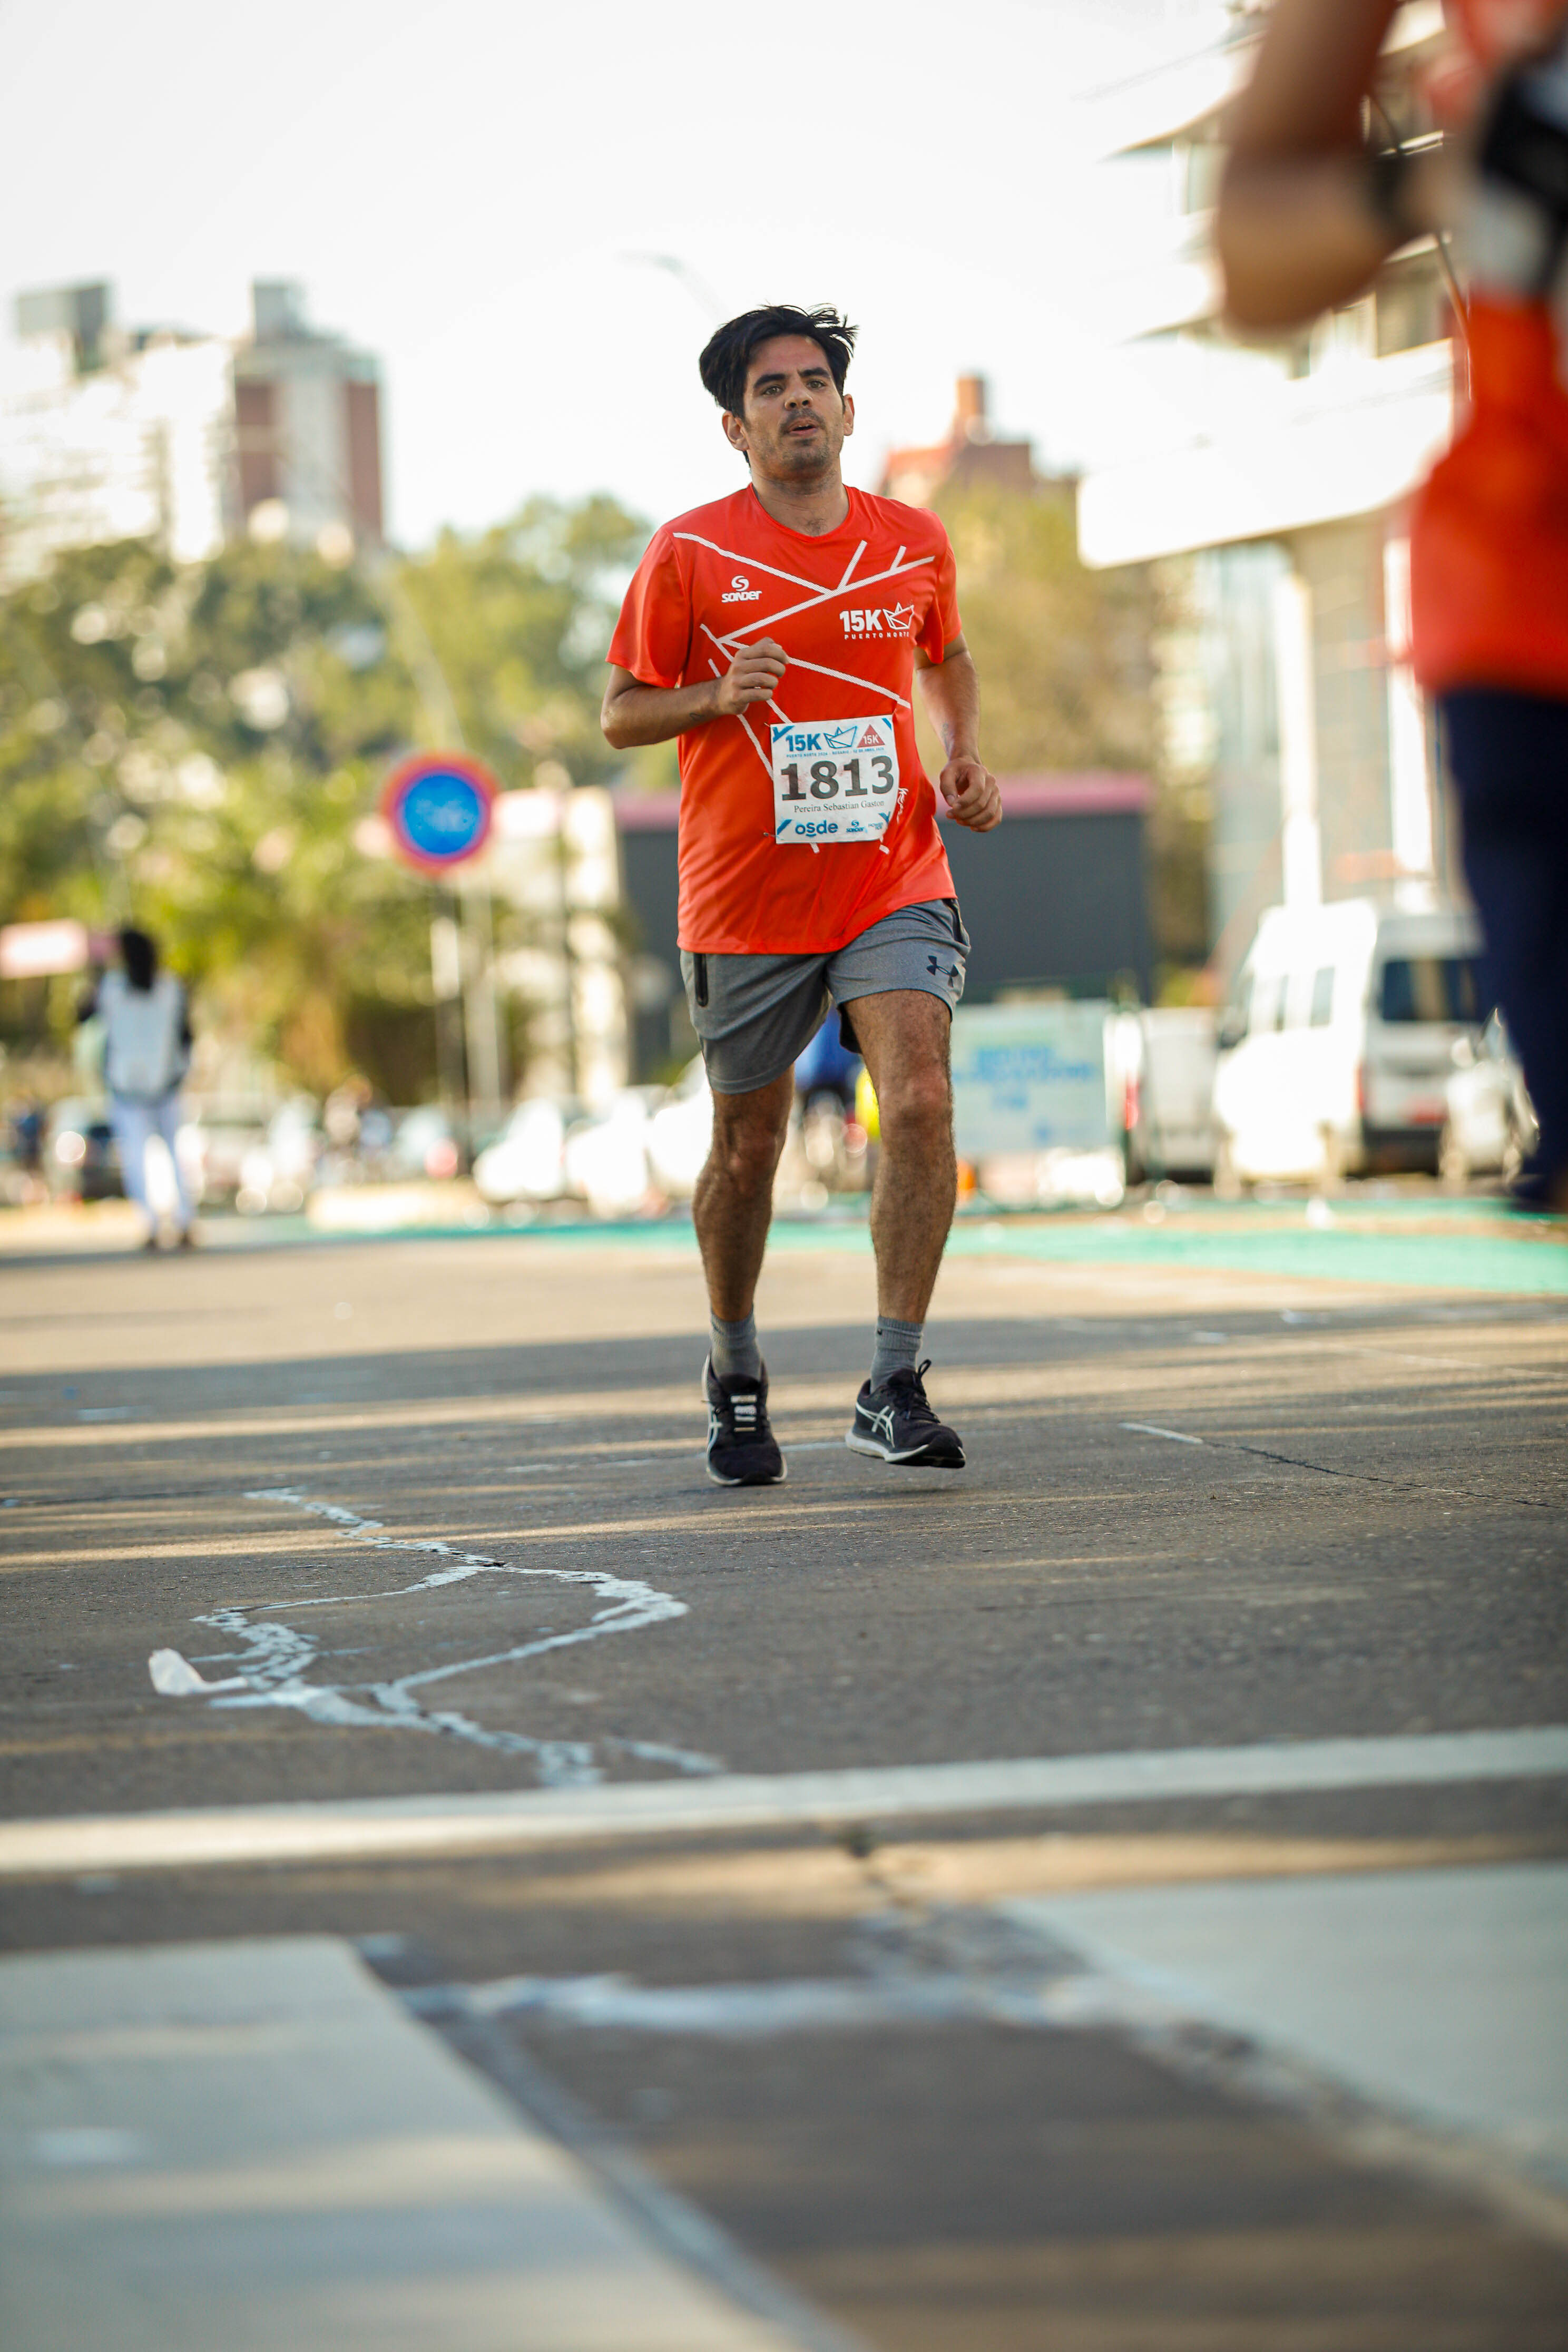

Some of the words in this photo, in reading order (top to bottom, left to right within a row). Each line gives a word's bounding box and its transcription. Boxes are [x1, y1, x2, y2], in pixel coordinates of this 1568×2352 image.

[839, 610, 883, 632] 15K
[785, 733, 821, 752] 15K
[863, 734, 879, 744] 15K
[781, 755, 894, 801] 1813
[794, 804, 821, 812] Pereira
[824, 801, 859, 811] Sebastian
[795, 819, 838, 835] osde
